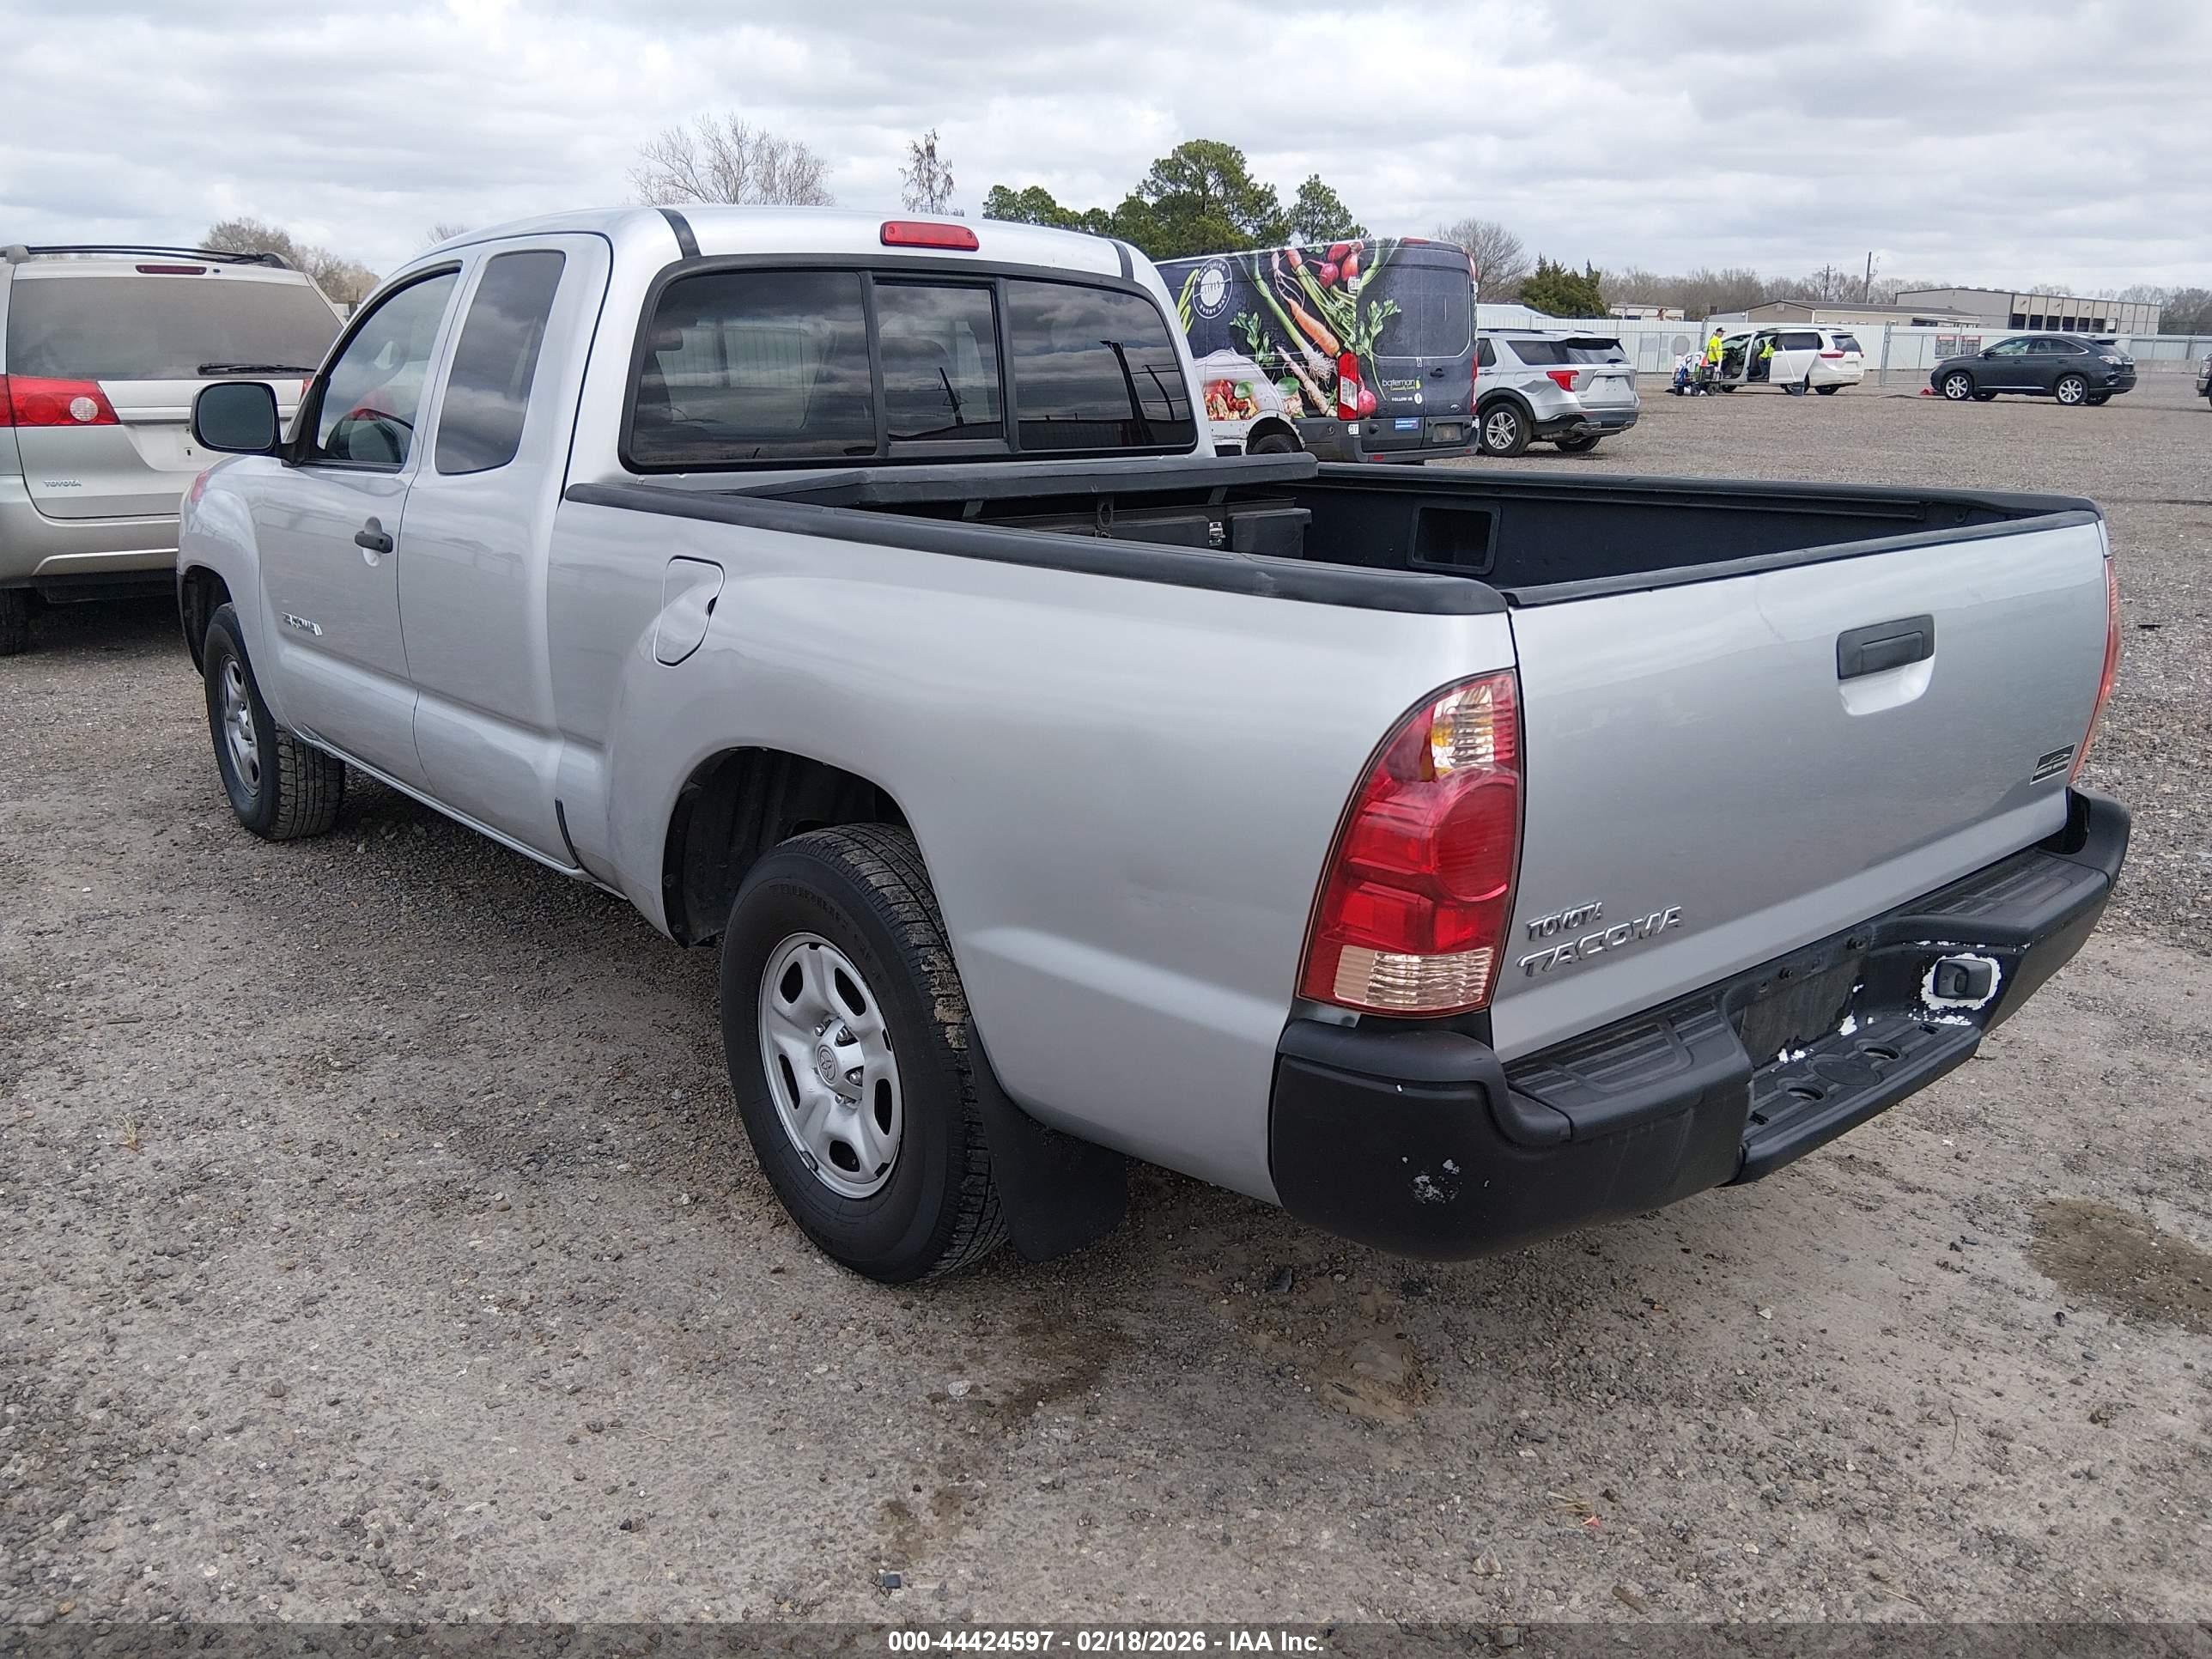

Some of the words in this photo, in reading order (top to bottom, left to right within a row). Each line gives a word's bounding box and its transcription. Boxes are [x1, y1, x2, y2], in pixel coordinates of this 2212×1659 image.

[1199, 303, 1217, 314] EVERY
[1218, 293, 1227, 309] DAY
[1517, 905, 1684, 977] TACOMA
[1526, 901, 1602, 941] TOYOTA
